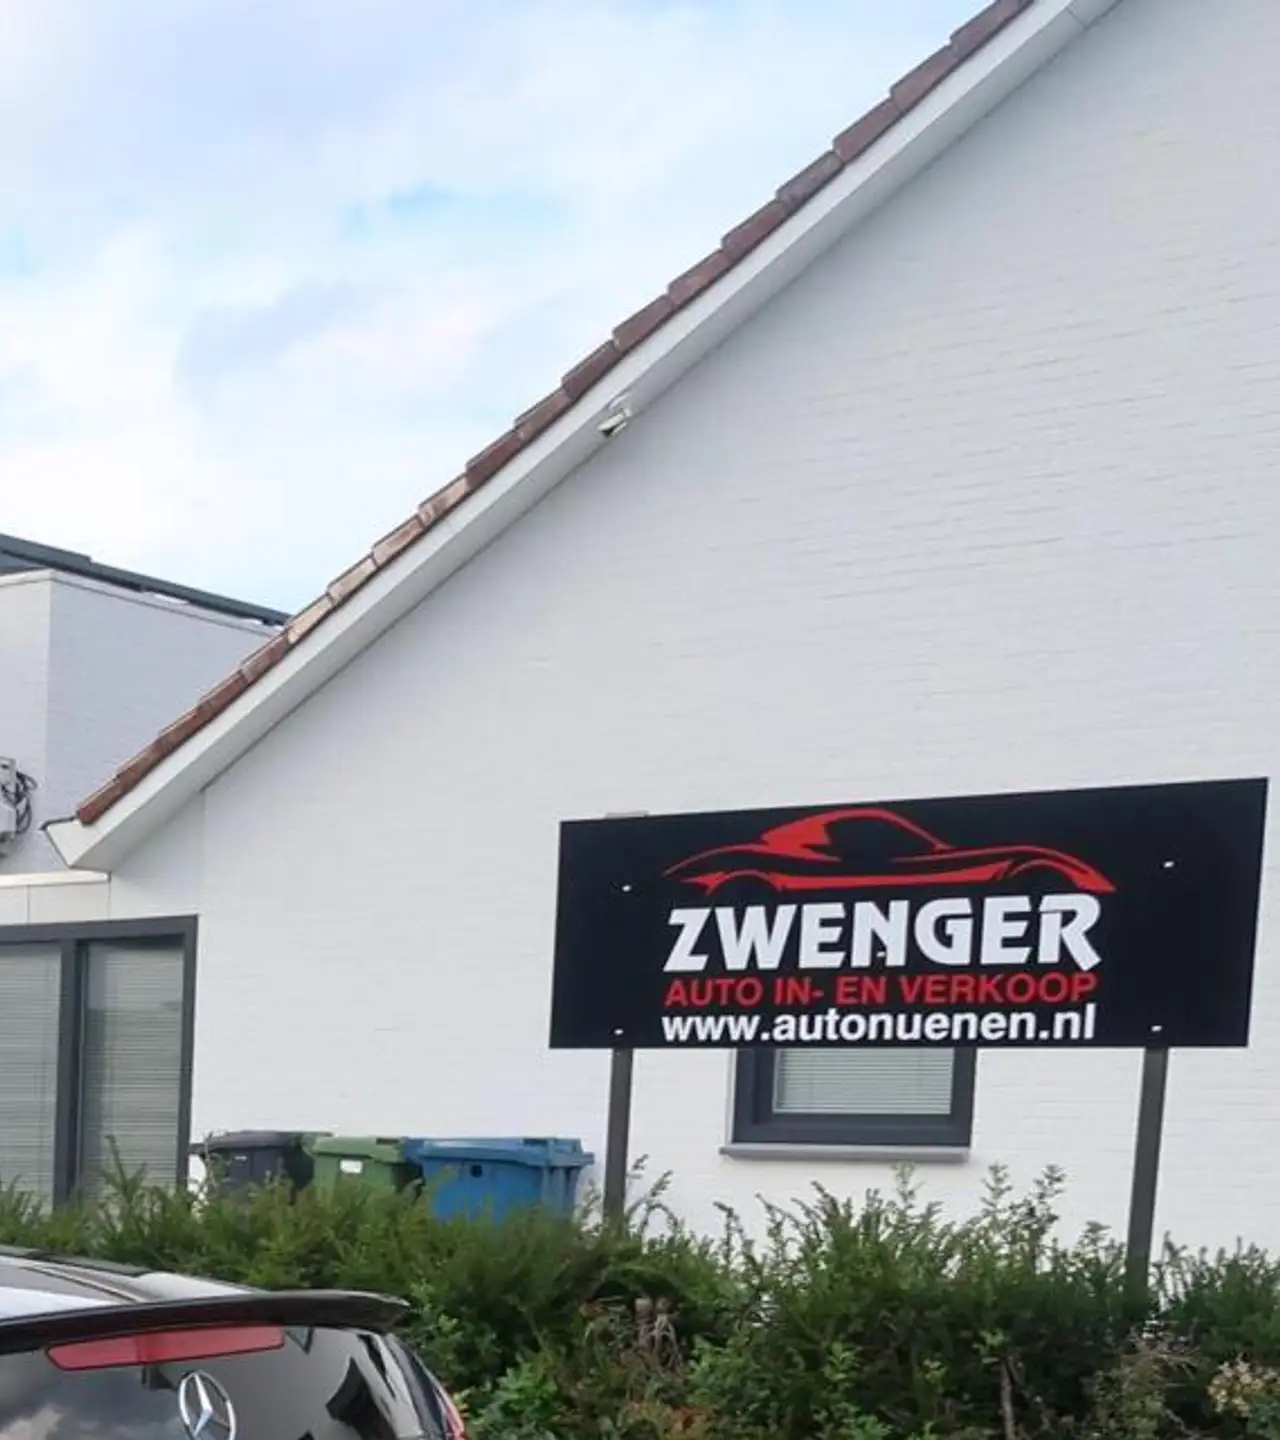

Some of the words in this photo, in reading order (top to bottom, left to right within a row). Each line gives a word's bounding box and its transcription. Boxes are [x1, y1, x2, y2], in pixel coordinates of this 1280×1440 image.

[662, 893, 1102, 972] ZWENGER
[664, 978, 763, 1008] AUTO
[774, 977, 824, 1006] IN-
[835, 976, 887, 1004] EN
[900, 972, 1098, 1003] VERKOOP
[662, 1004, 1096, 1042] www.autonuenen.nl
